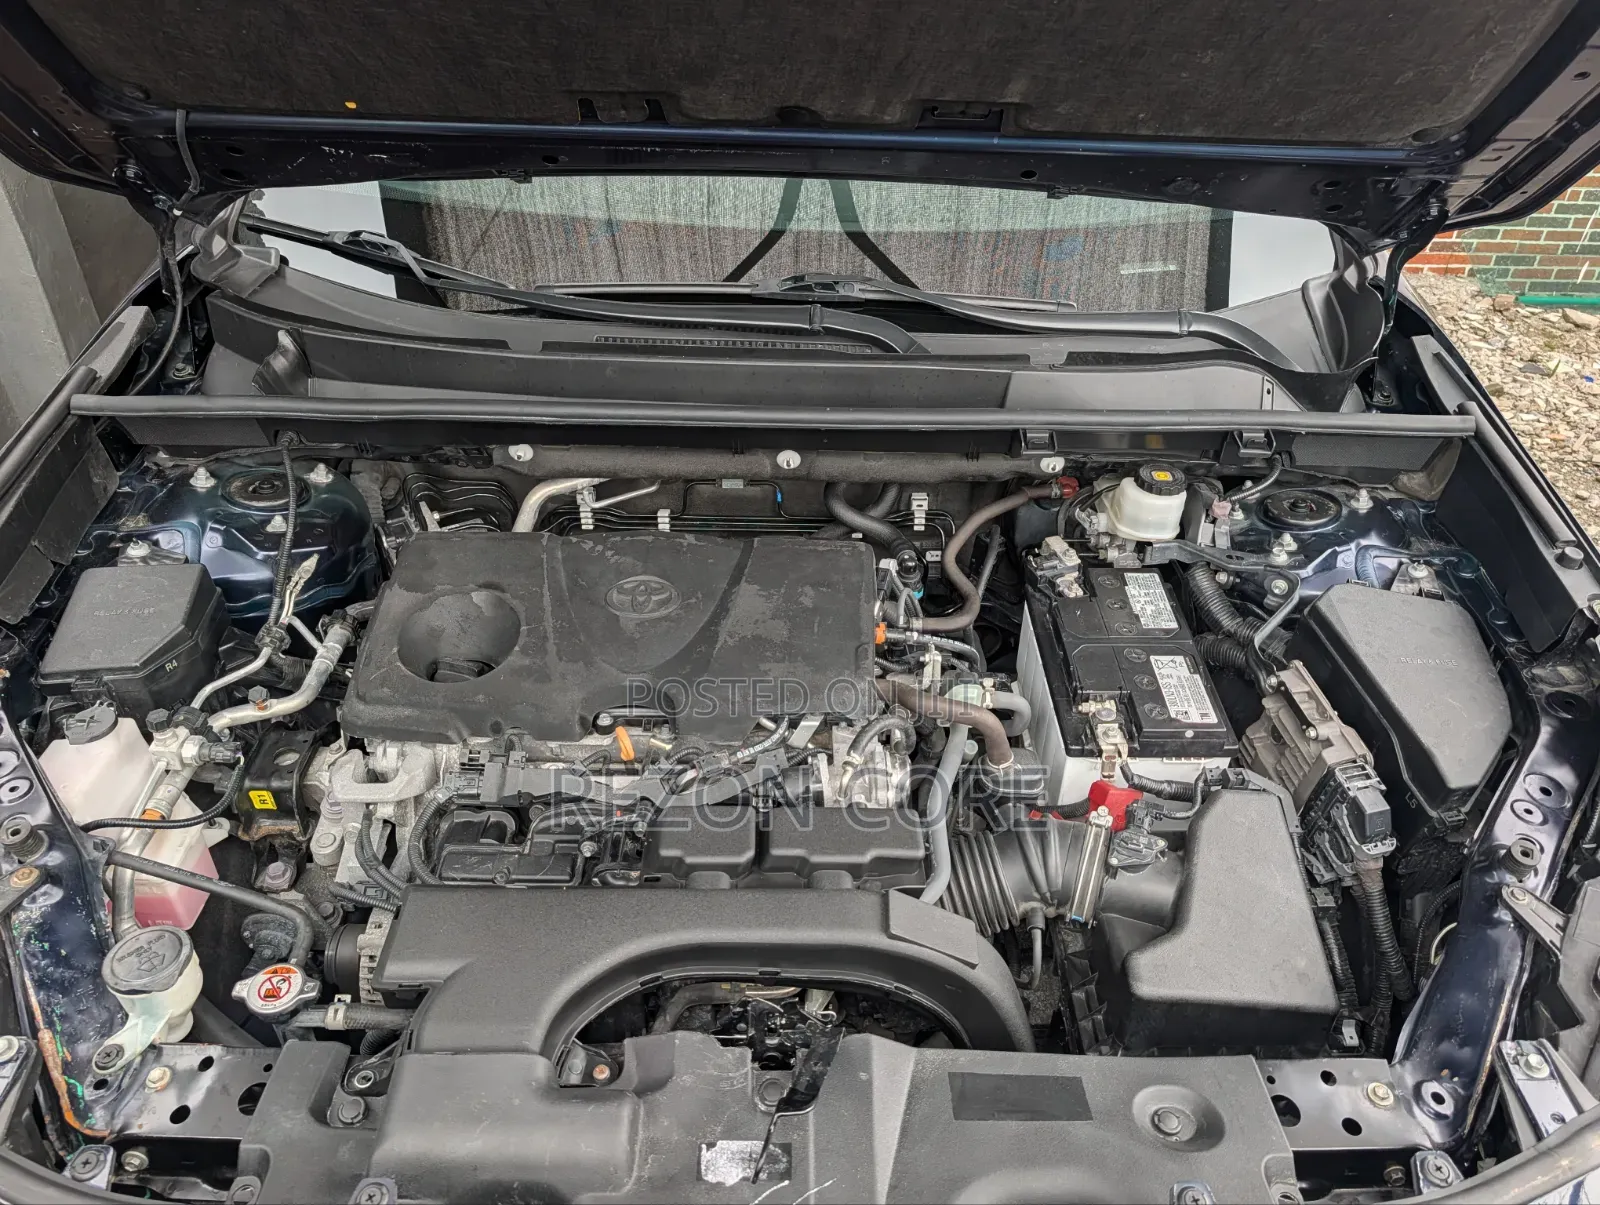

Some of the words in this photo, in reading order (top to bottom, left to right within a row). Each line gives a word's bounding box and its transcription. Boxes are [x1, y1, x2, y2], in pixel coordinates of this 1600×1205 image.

[165, 659, 178, 672] R4
[1400, 657, 1427, 665] RELAY
[1435, 659, 1459, 667] FUSE
[257, 794, 270, 805] R1
